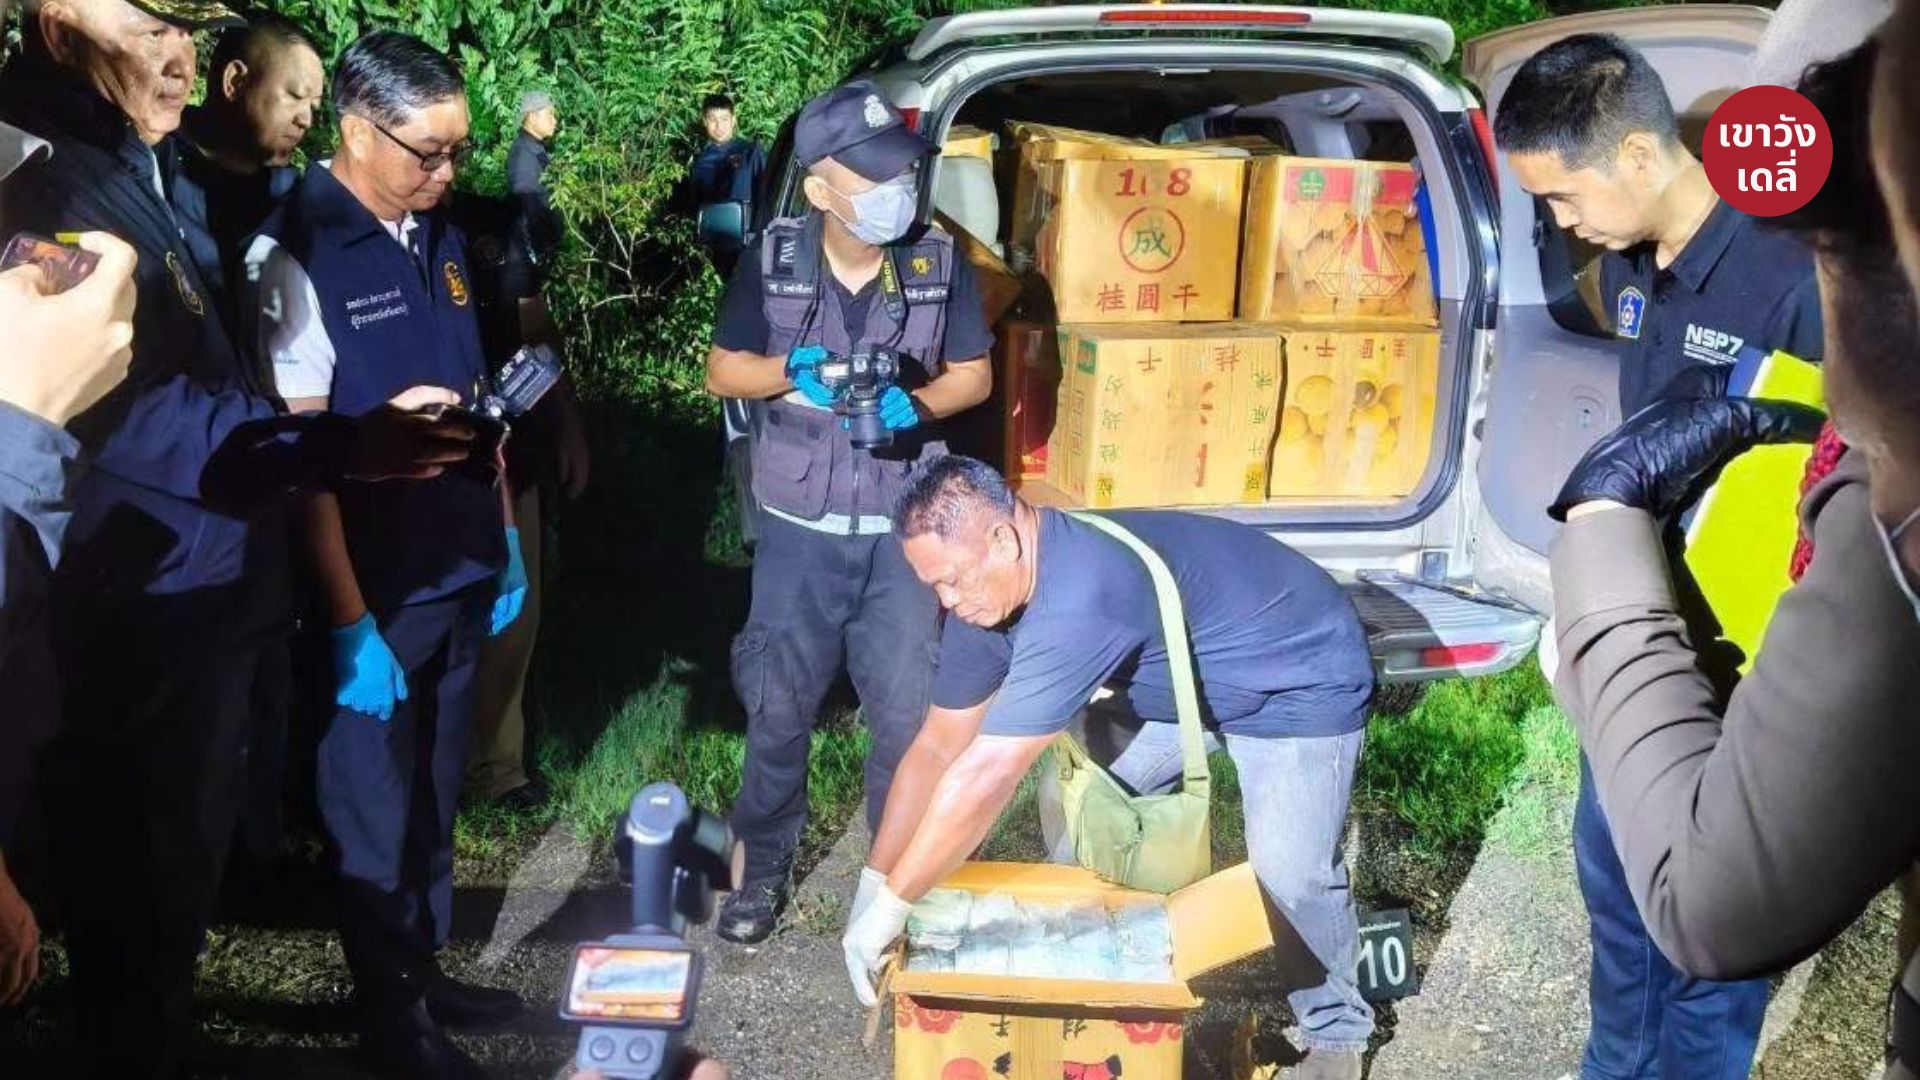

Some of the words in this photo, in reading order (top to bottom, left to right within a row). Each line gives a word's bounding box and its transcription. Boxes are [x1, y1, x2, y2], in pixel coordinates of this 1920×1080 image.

[1127, 215, 1172, 260] 成
[1684, 322, 1745, 356] NSP7
[1358, 935, 1407, 989] 10
